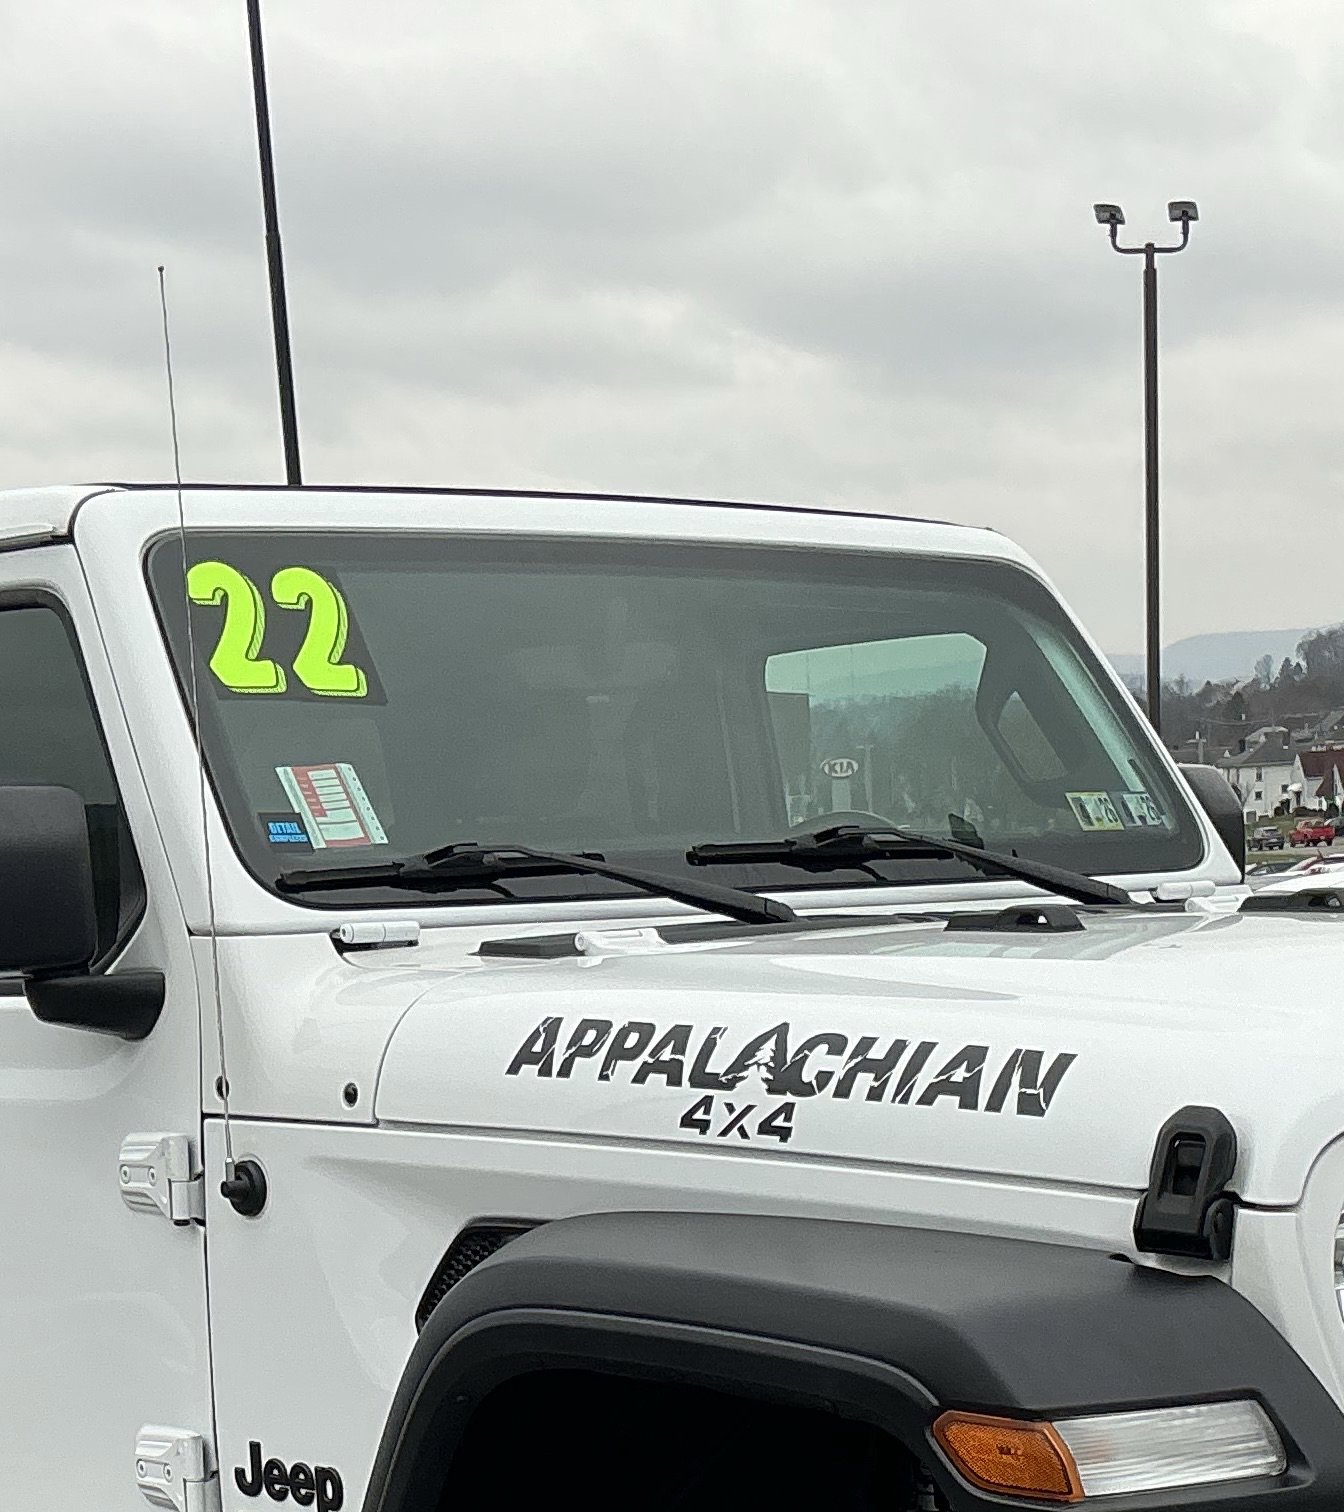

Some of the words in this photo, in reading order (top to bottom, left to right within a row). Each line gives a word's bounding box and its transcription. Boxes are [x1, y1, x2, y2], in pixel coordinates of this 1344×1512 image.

[186, 561, 368, 697] 22
[825, 759, 855, 777] KIA
[505, 1016, 1079, 1118] APPALACHIAN
